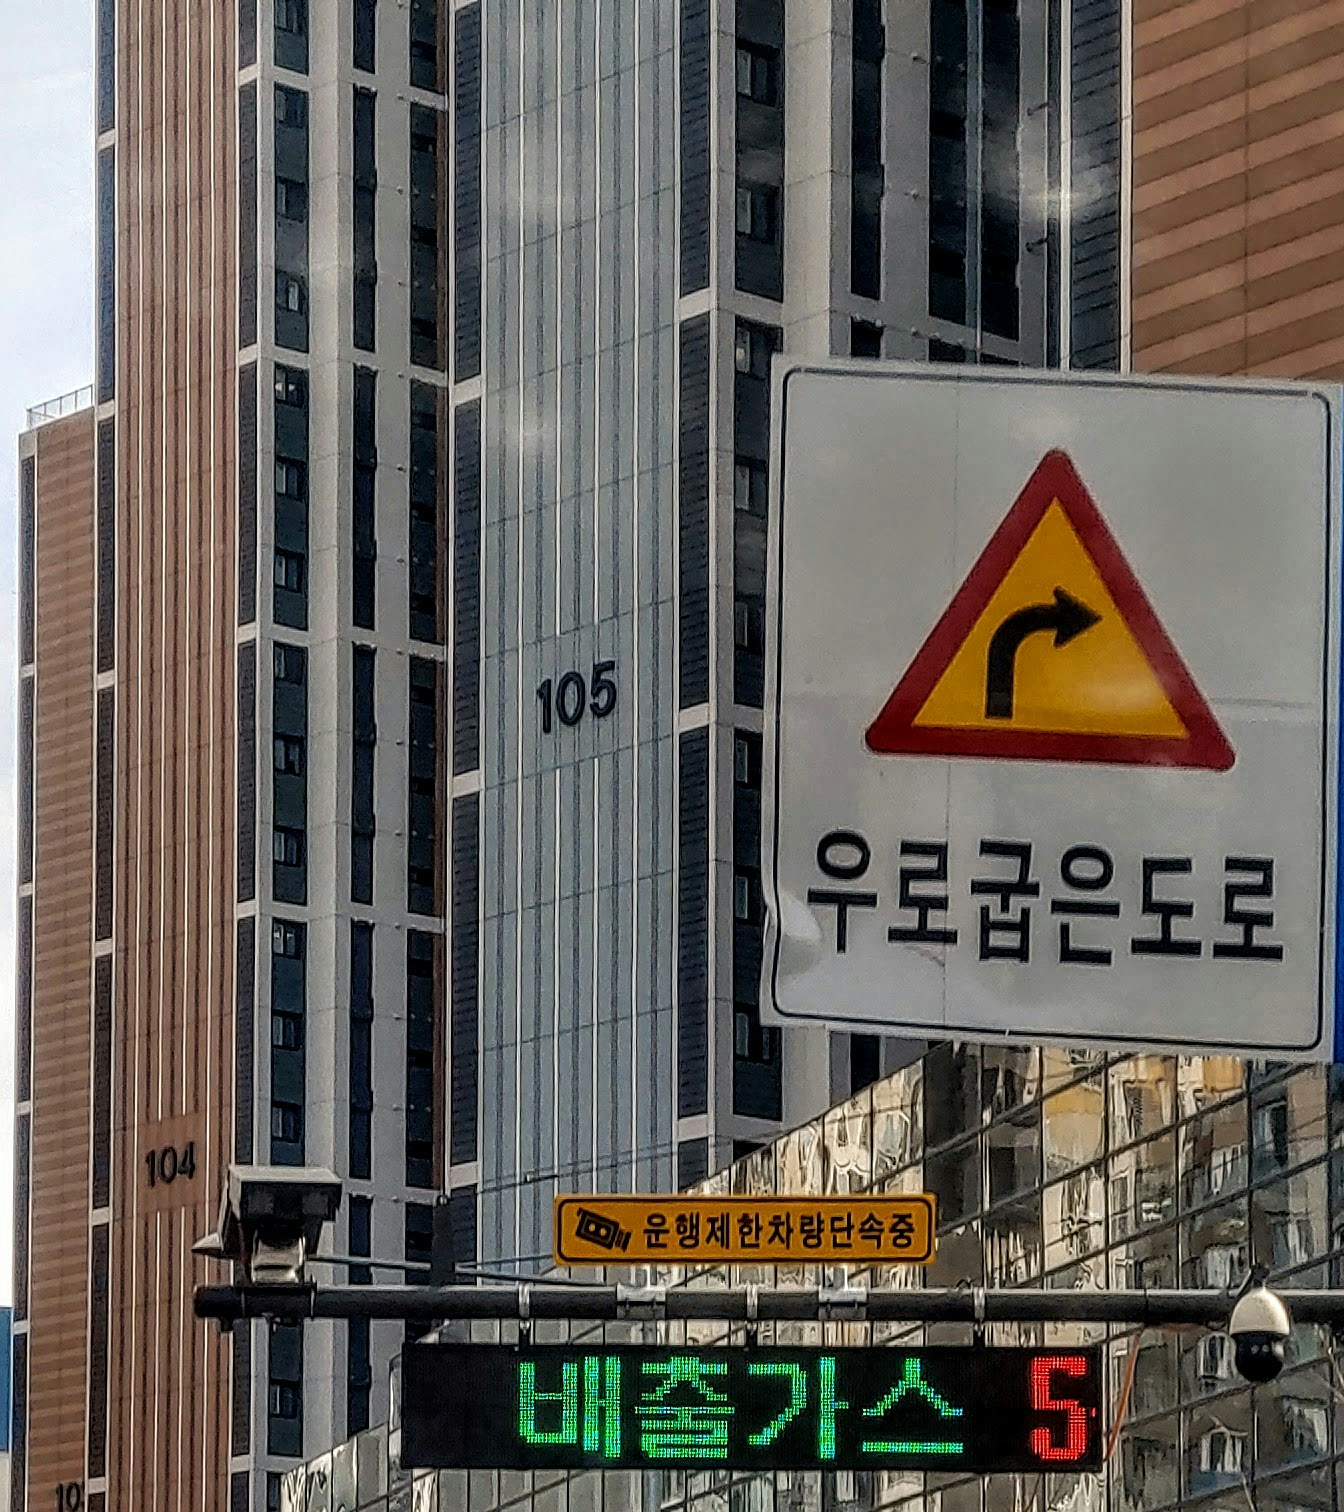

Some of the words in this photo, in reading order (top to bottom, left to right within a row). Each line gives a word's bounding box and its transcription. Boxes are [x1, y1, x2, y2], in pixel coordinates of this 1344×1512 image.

[536, 660, 617, 735] 105
[807, 828, 1284, 966] 우로굽은도로
[145, 1141, 196, 1188] 104
[517, 1355, 964, 1461] 배출가스
[1030, 1356, 1087, 1460] 5
